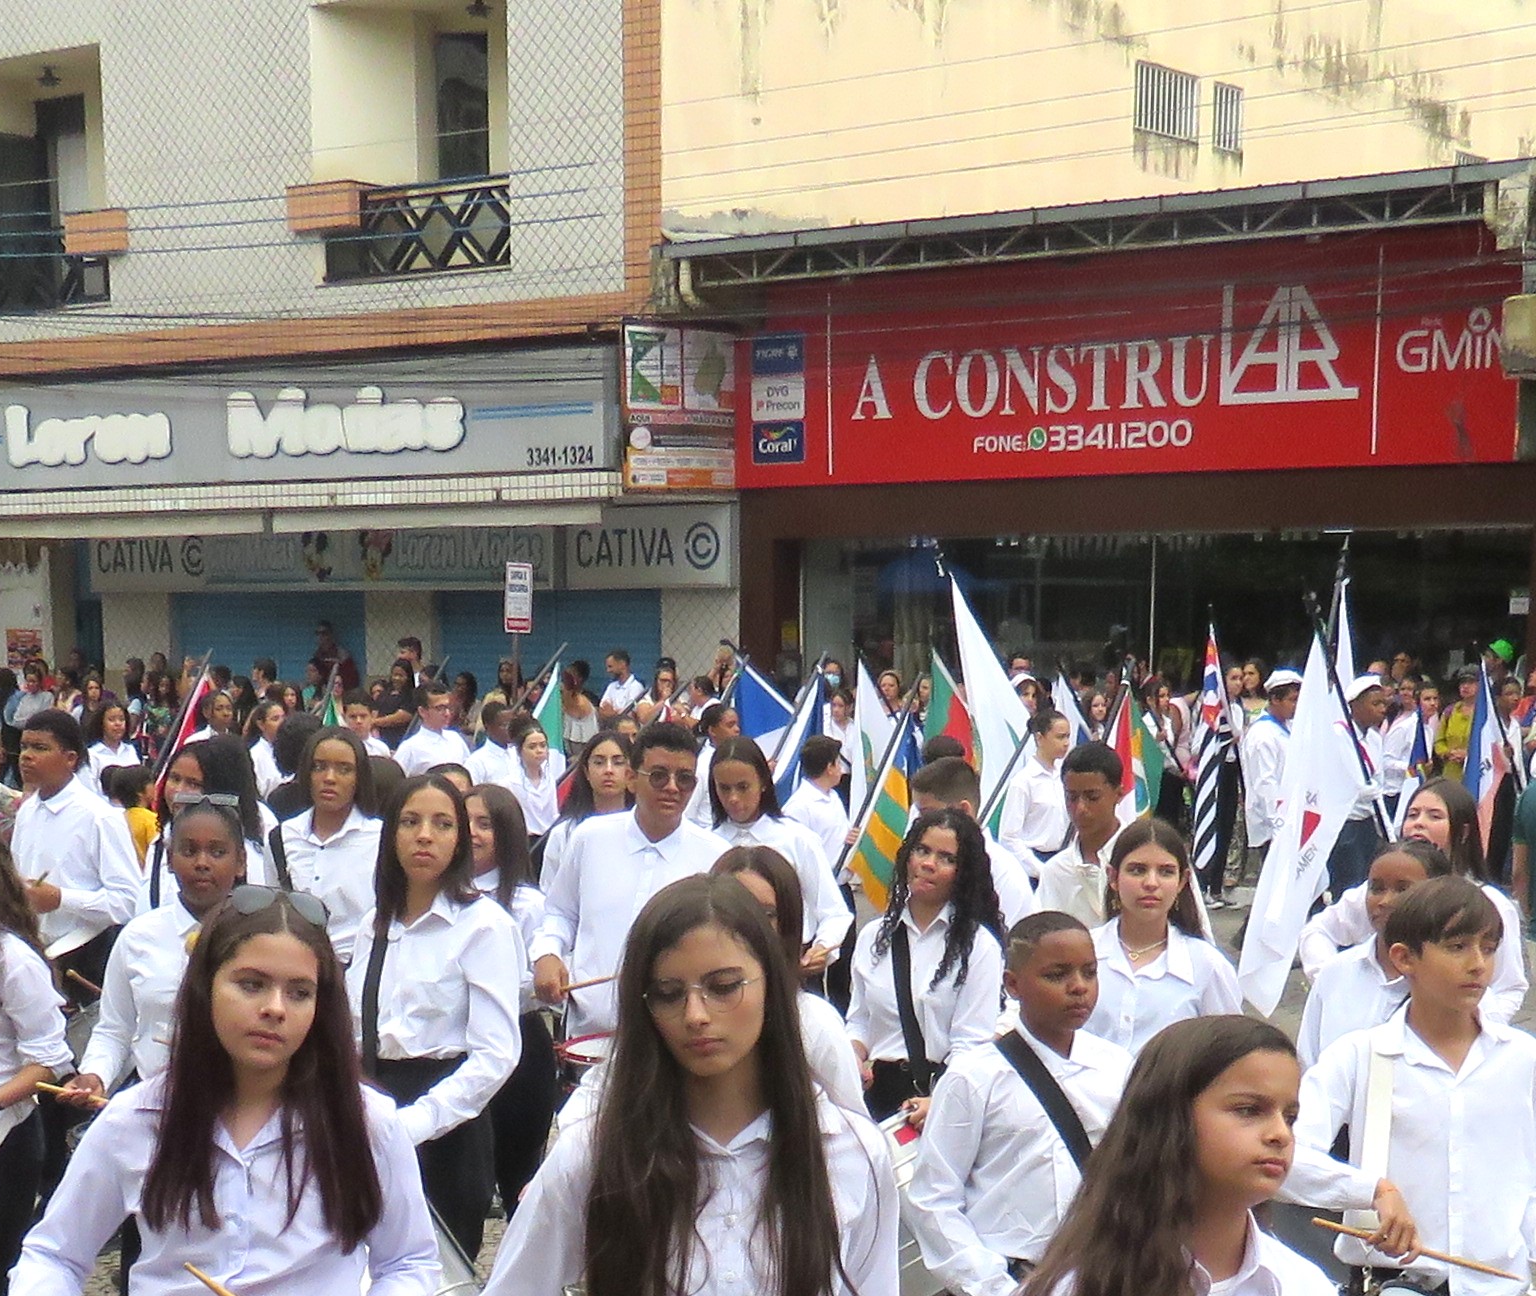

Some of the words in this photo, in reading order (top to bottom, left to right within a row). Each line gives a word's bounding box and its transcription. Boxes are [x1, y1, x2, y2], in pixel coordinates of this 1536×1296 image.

[766, 386, 790, 397] DYG
[851, 353, 893, 421] A
[766, 401, 800, 412] Precon
[6, 403, 173, 468] Loren
[226, 385, 467, 459] Modas
[1048, 418, 1194, 453] 3341.1200
[526, 446, 594, 466] 3341-1324
[758, 439, 793, 453] Coral
[96, 539, 174, 574] CATIVA
[576, 528, 675, 568] CATIVA
